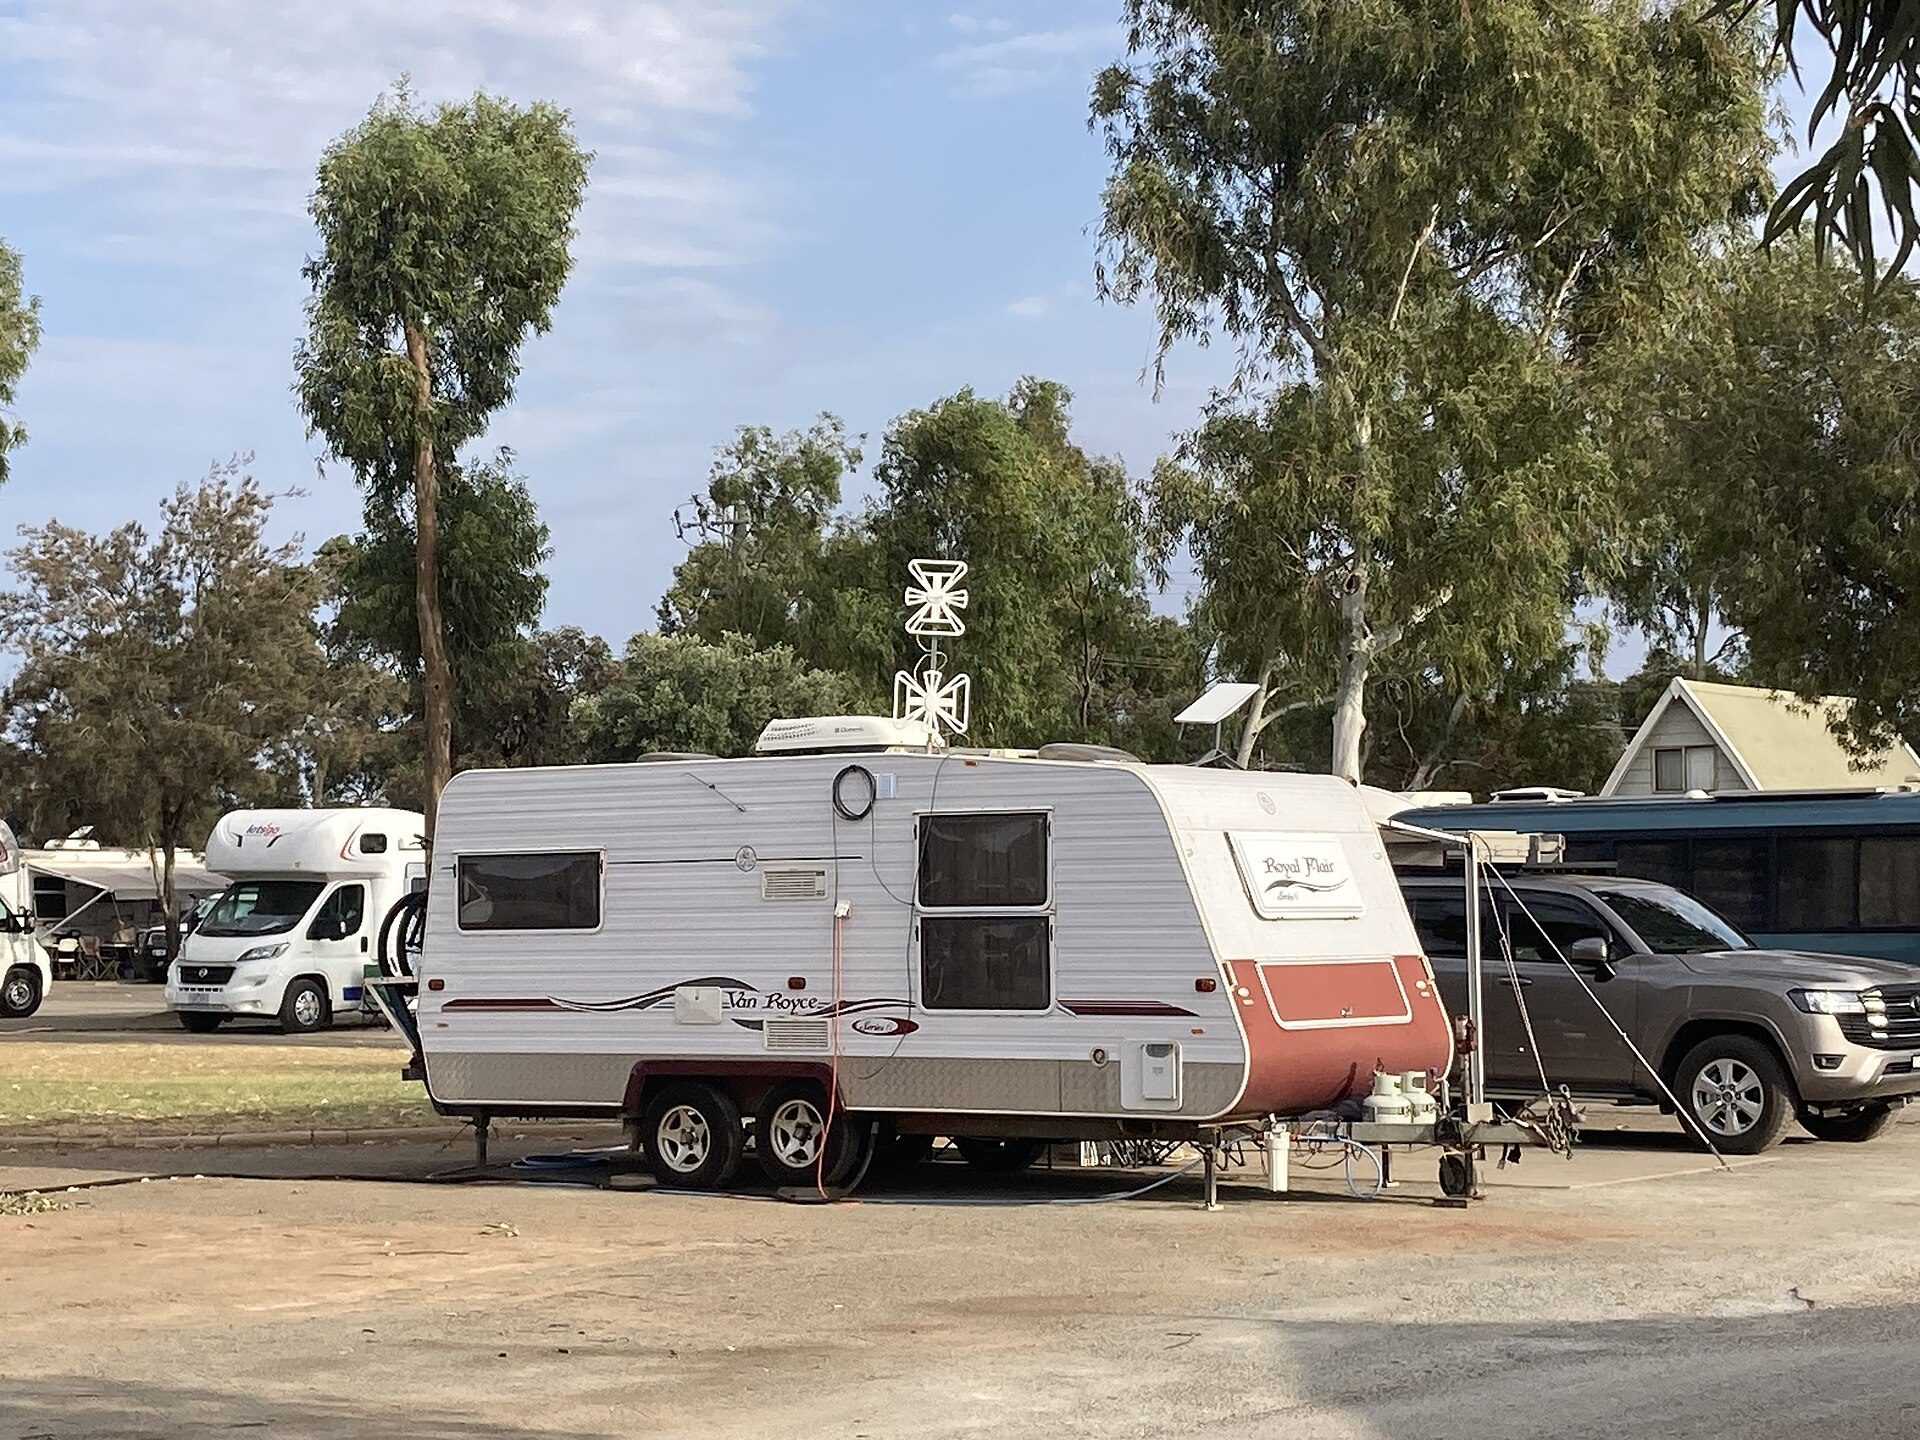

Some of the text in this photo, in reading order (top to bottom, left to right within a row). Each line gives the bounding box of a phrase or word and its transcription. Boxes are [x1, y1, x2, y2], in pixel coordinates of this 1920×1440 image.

[1263, 856, 1334, 878] Royal Flair
[724, 991, 818, 1015] Van Royce
